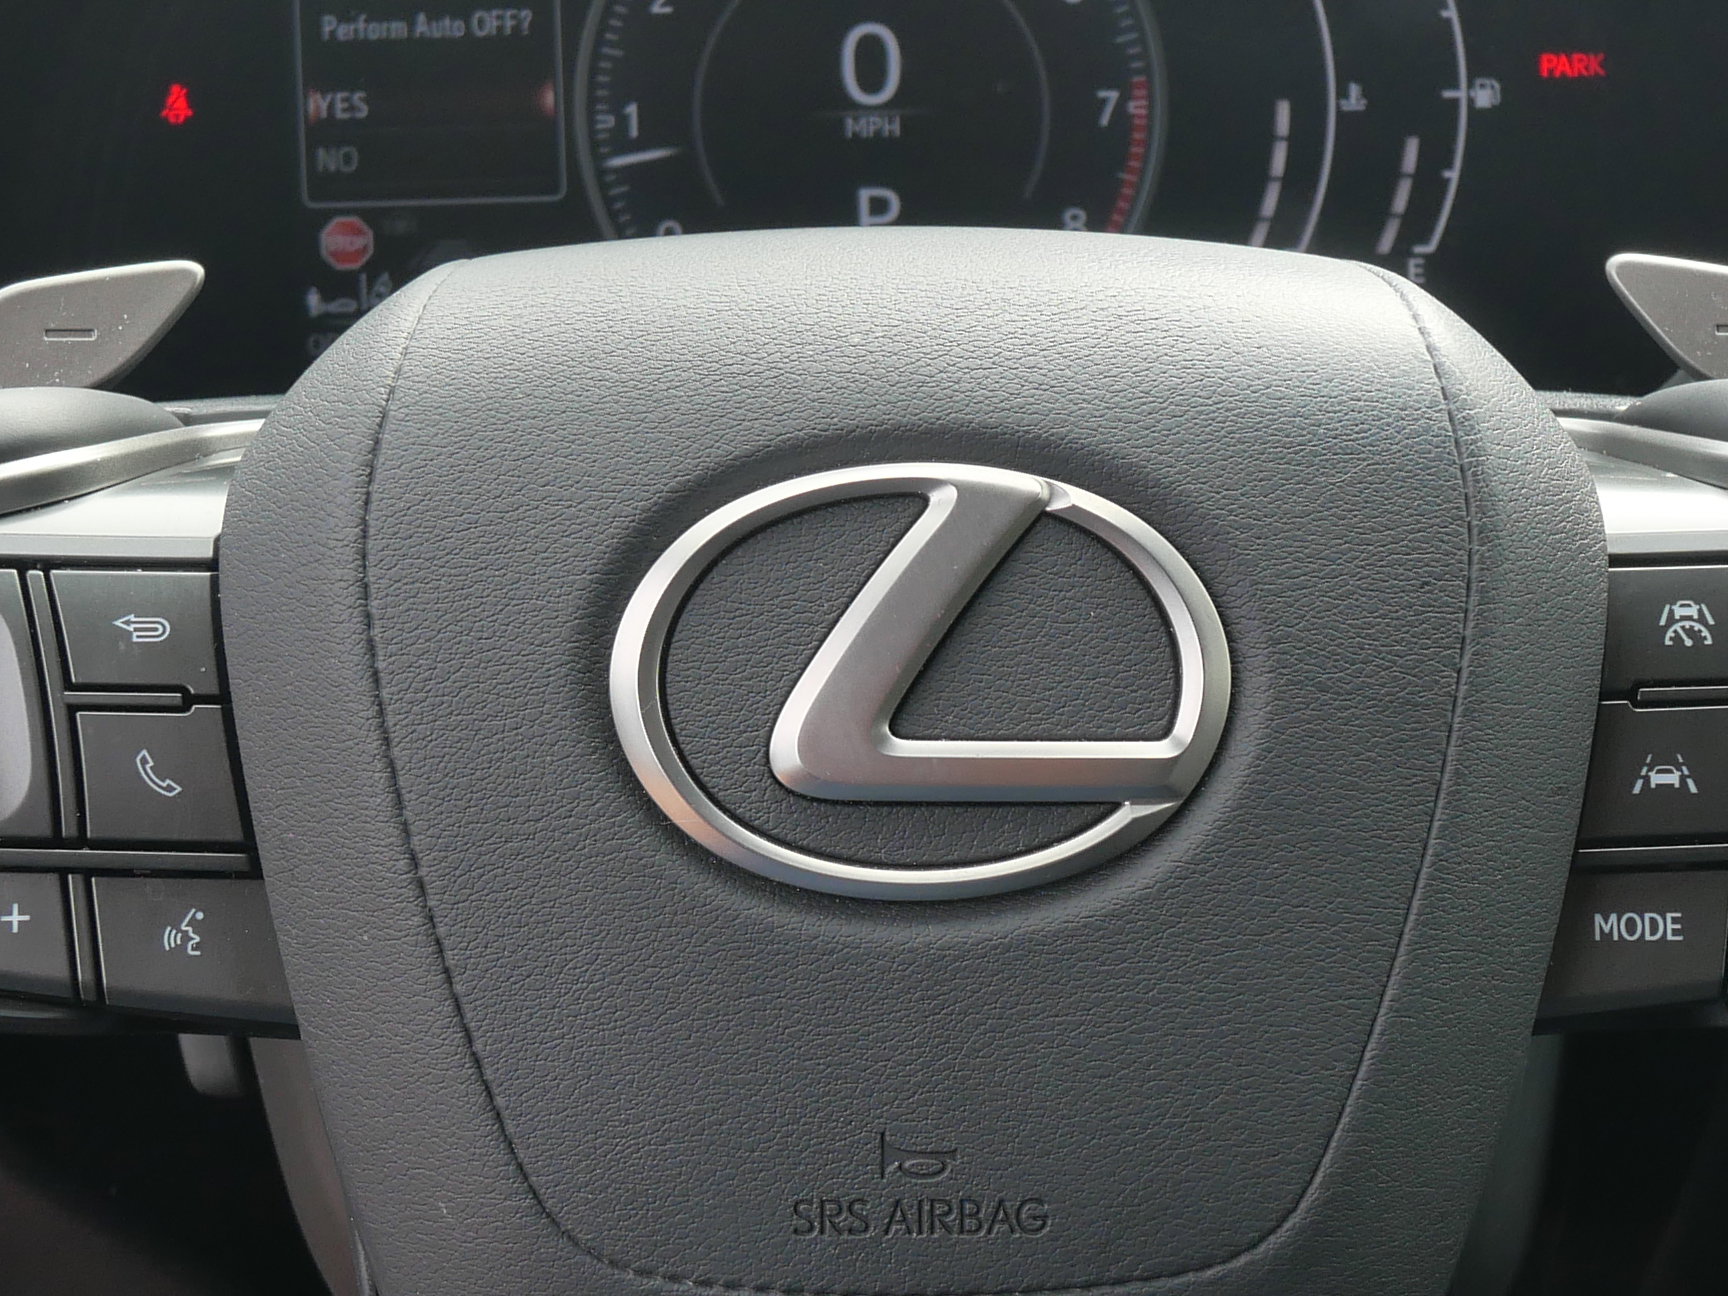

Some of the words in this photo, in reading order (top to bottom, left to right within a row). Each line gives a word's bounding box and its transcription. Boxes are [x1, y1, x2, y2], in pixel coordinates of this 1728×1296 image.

[321, 13, 408, 42] Perform
[414, 11, 466, 39] Auto
[472, 9, 534, 37] OFF?
[840, 22, 902, 106] 0
[1539, 52, 1606, 78] PARK
[318, 91, 369, 120] YES
[624, 103, 639, 139] 1
[1096, 91, 1120, 127] 7
[845, 116, 901, 139] MPH
[315, 145, 359, 174] NO
[857, 187, 901, 226] P
[1407, 258, 1426, 284] E
[1594, 912, 1684, 942] MODE
[792, 1198, 871, 1237] SRS
[883, 1197, 1052, 1238] AIRBAG
